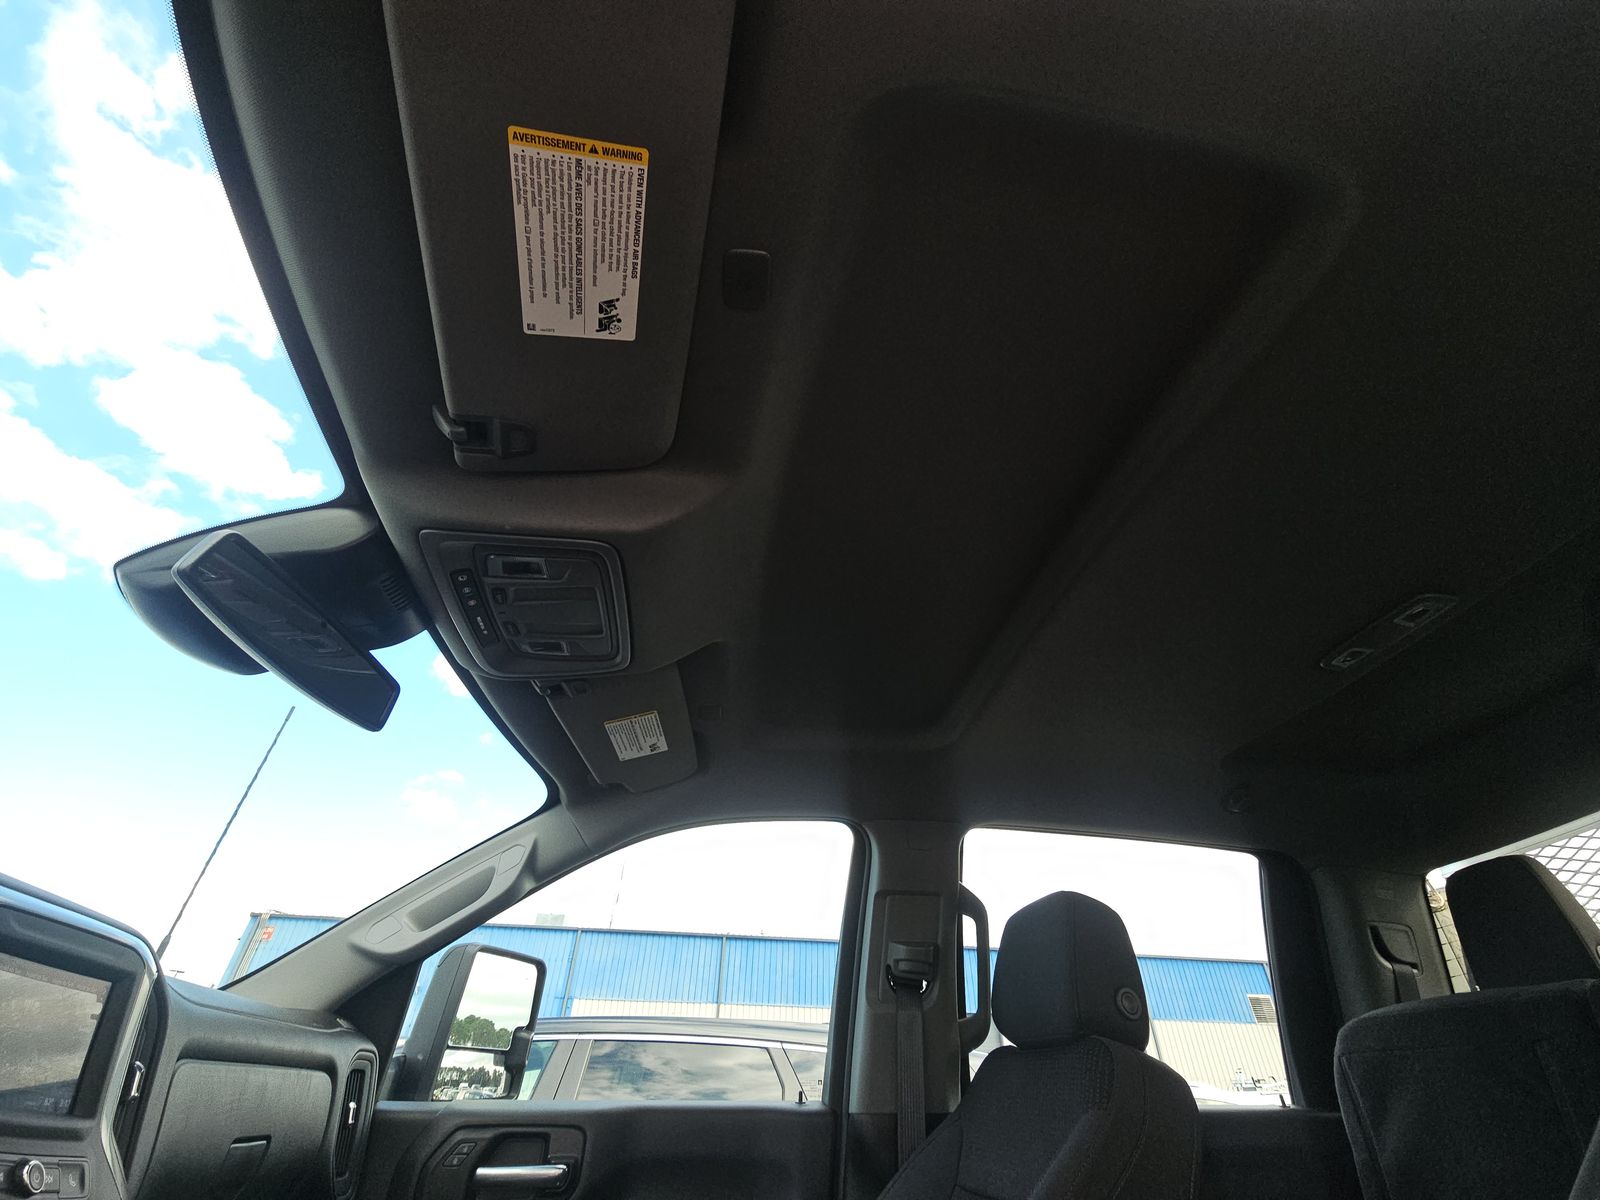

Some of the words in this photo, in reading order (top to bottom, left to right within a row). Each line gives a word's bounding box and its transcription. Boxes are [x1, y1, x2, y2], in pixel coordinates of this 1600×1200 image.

[512, 131, 587, 153] AVERTISSEMENT
[602, 146, 643, 162] WARNING
[575, 182, 583, 202] AVEC
[575, 203, 583, 216] DES
[575, 217, 583, 236] SACS
